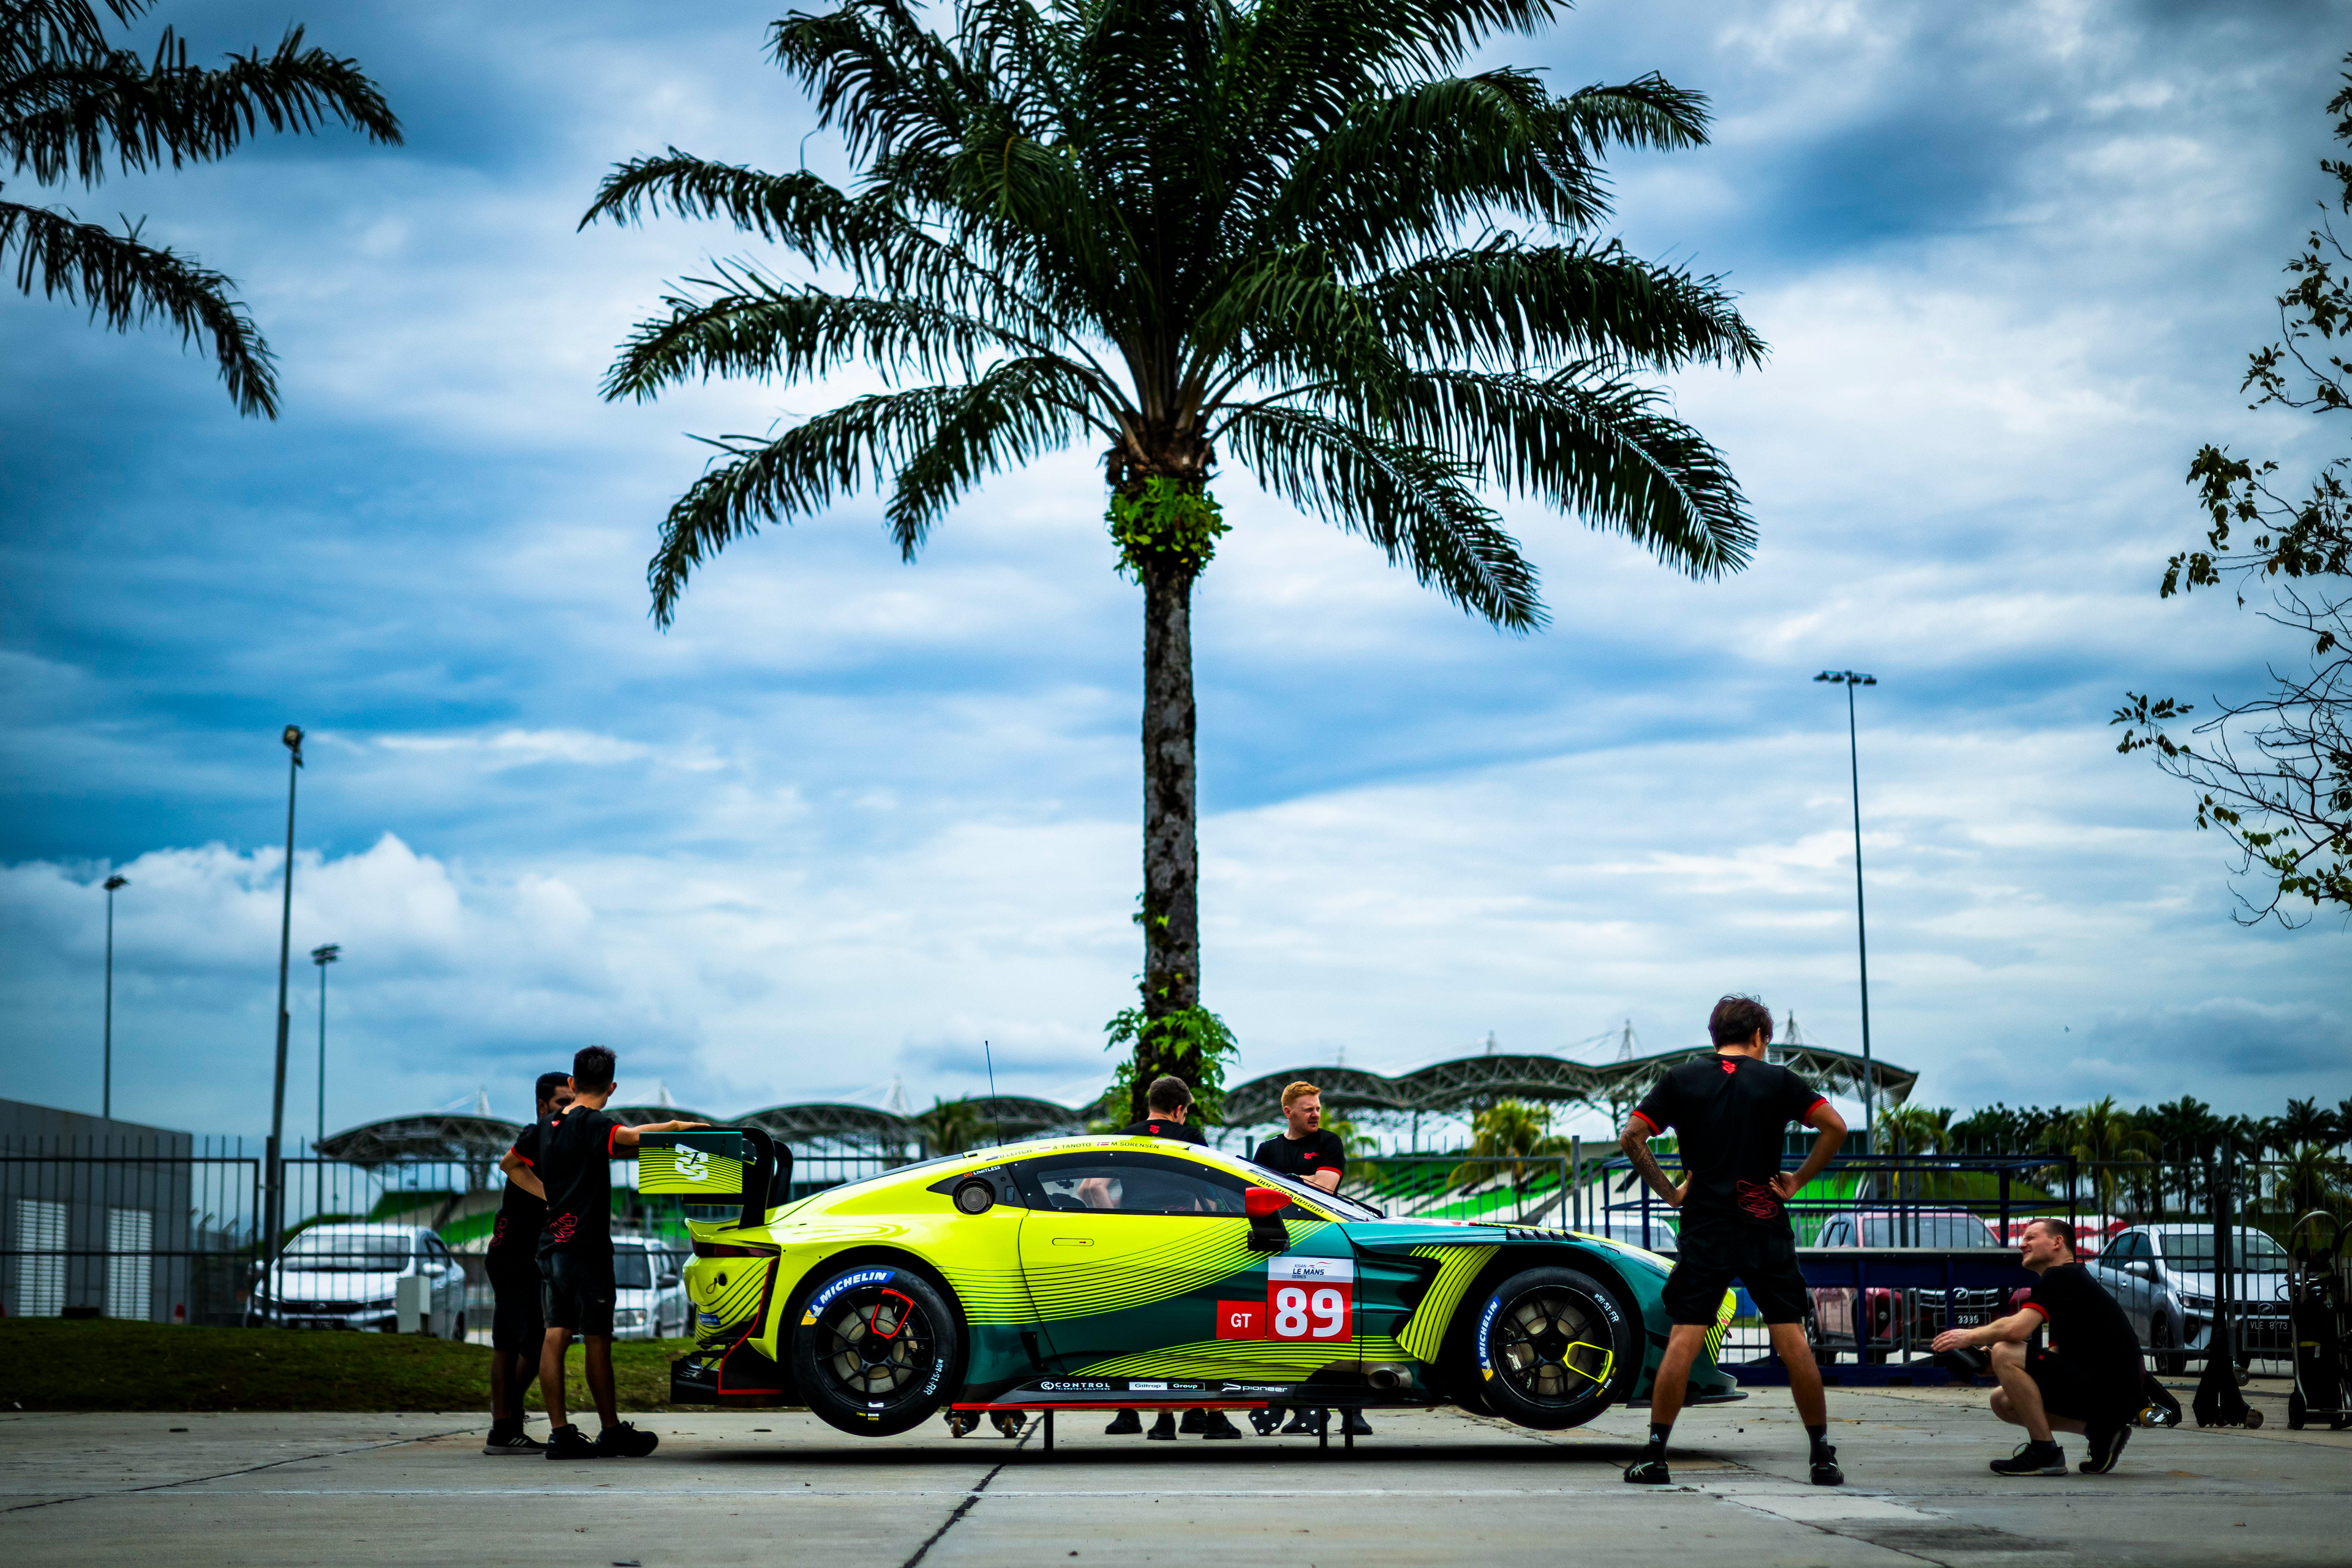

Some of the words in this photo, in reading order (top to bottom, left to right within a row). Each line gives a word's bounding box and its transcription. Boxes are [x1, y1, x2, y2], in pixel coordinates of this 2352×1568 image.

[973, 1165, 1001, 1175] LIMITLESS
[820, 1272, 888, 1305] MICHELIN
[1231, 1313, 1252, 1328] GT
[1275, 1287, 1344, 1337] 89
[1479, 1301, 1498, 1358] MICHELIN
